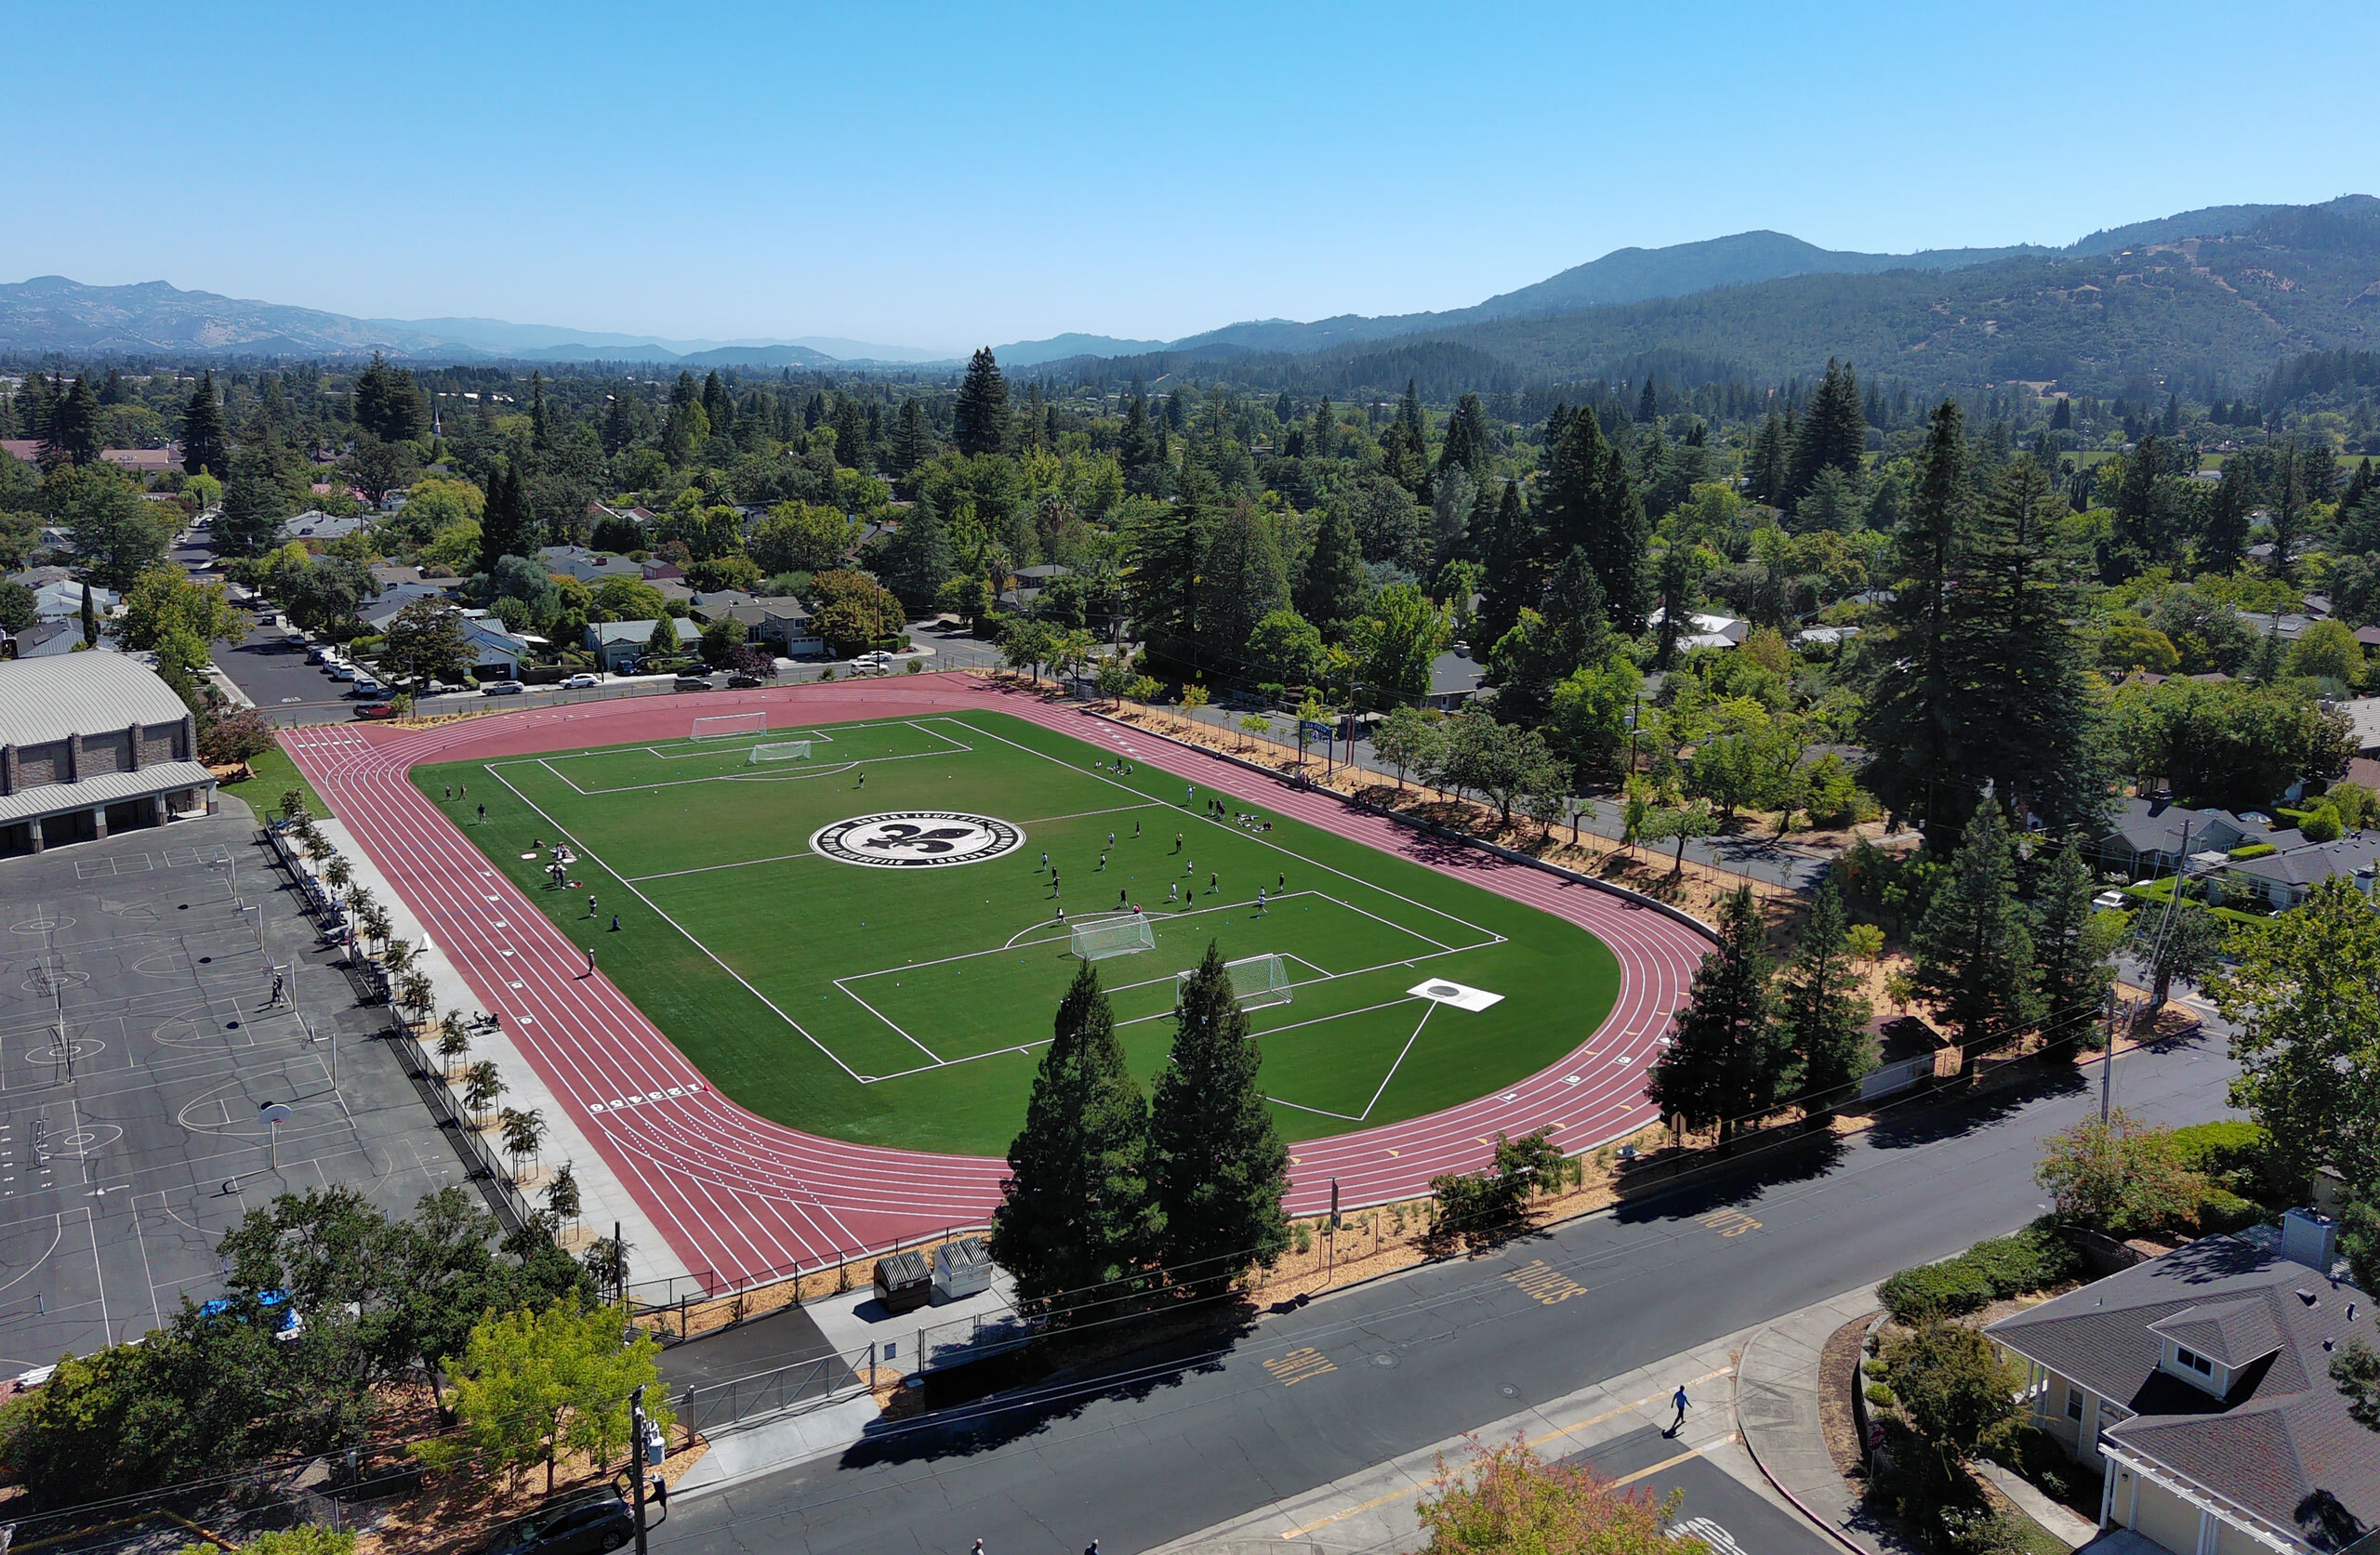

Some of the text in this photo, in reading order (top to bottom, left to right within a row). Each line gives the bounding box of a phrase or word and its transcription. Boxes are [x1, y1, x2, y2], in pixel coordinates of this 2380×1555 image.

[926, 853, 986, 864] SCHOOL
[648, 1091, 664, 1100] 3
[667, 1087, 682, 1096] 2
[610, 1099, 625, 1108] 5
[628, 1095, 643, 1104] 4
[1501, 1259, 1589, 1305] SCHOOL
